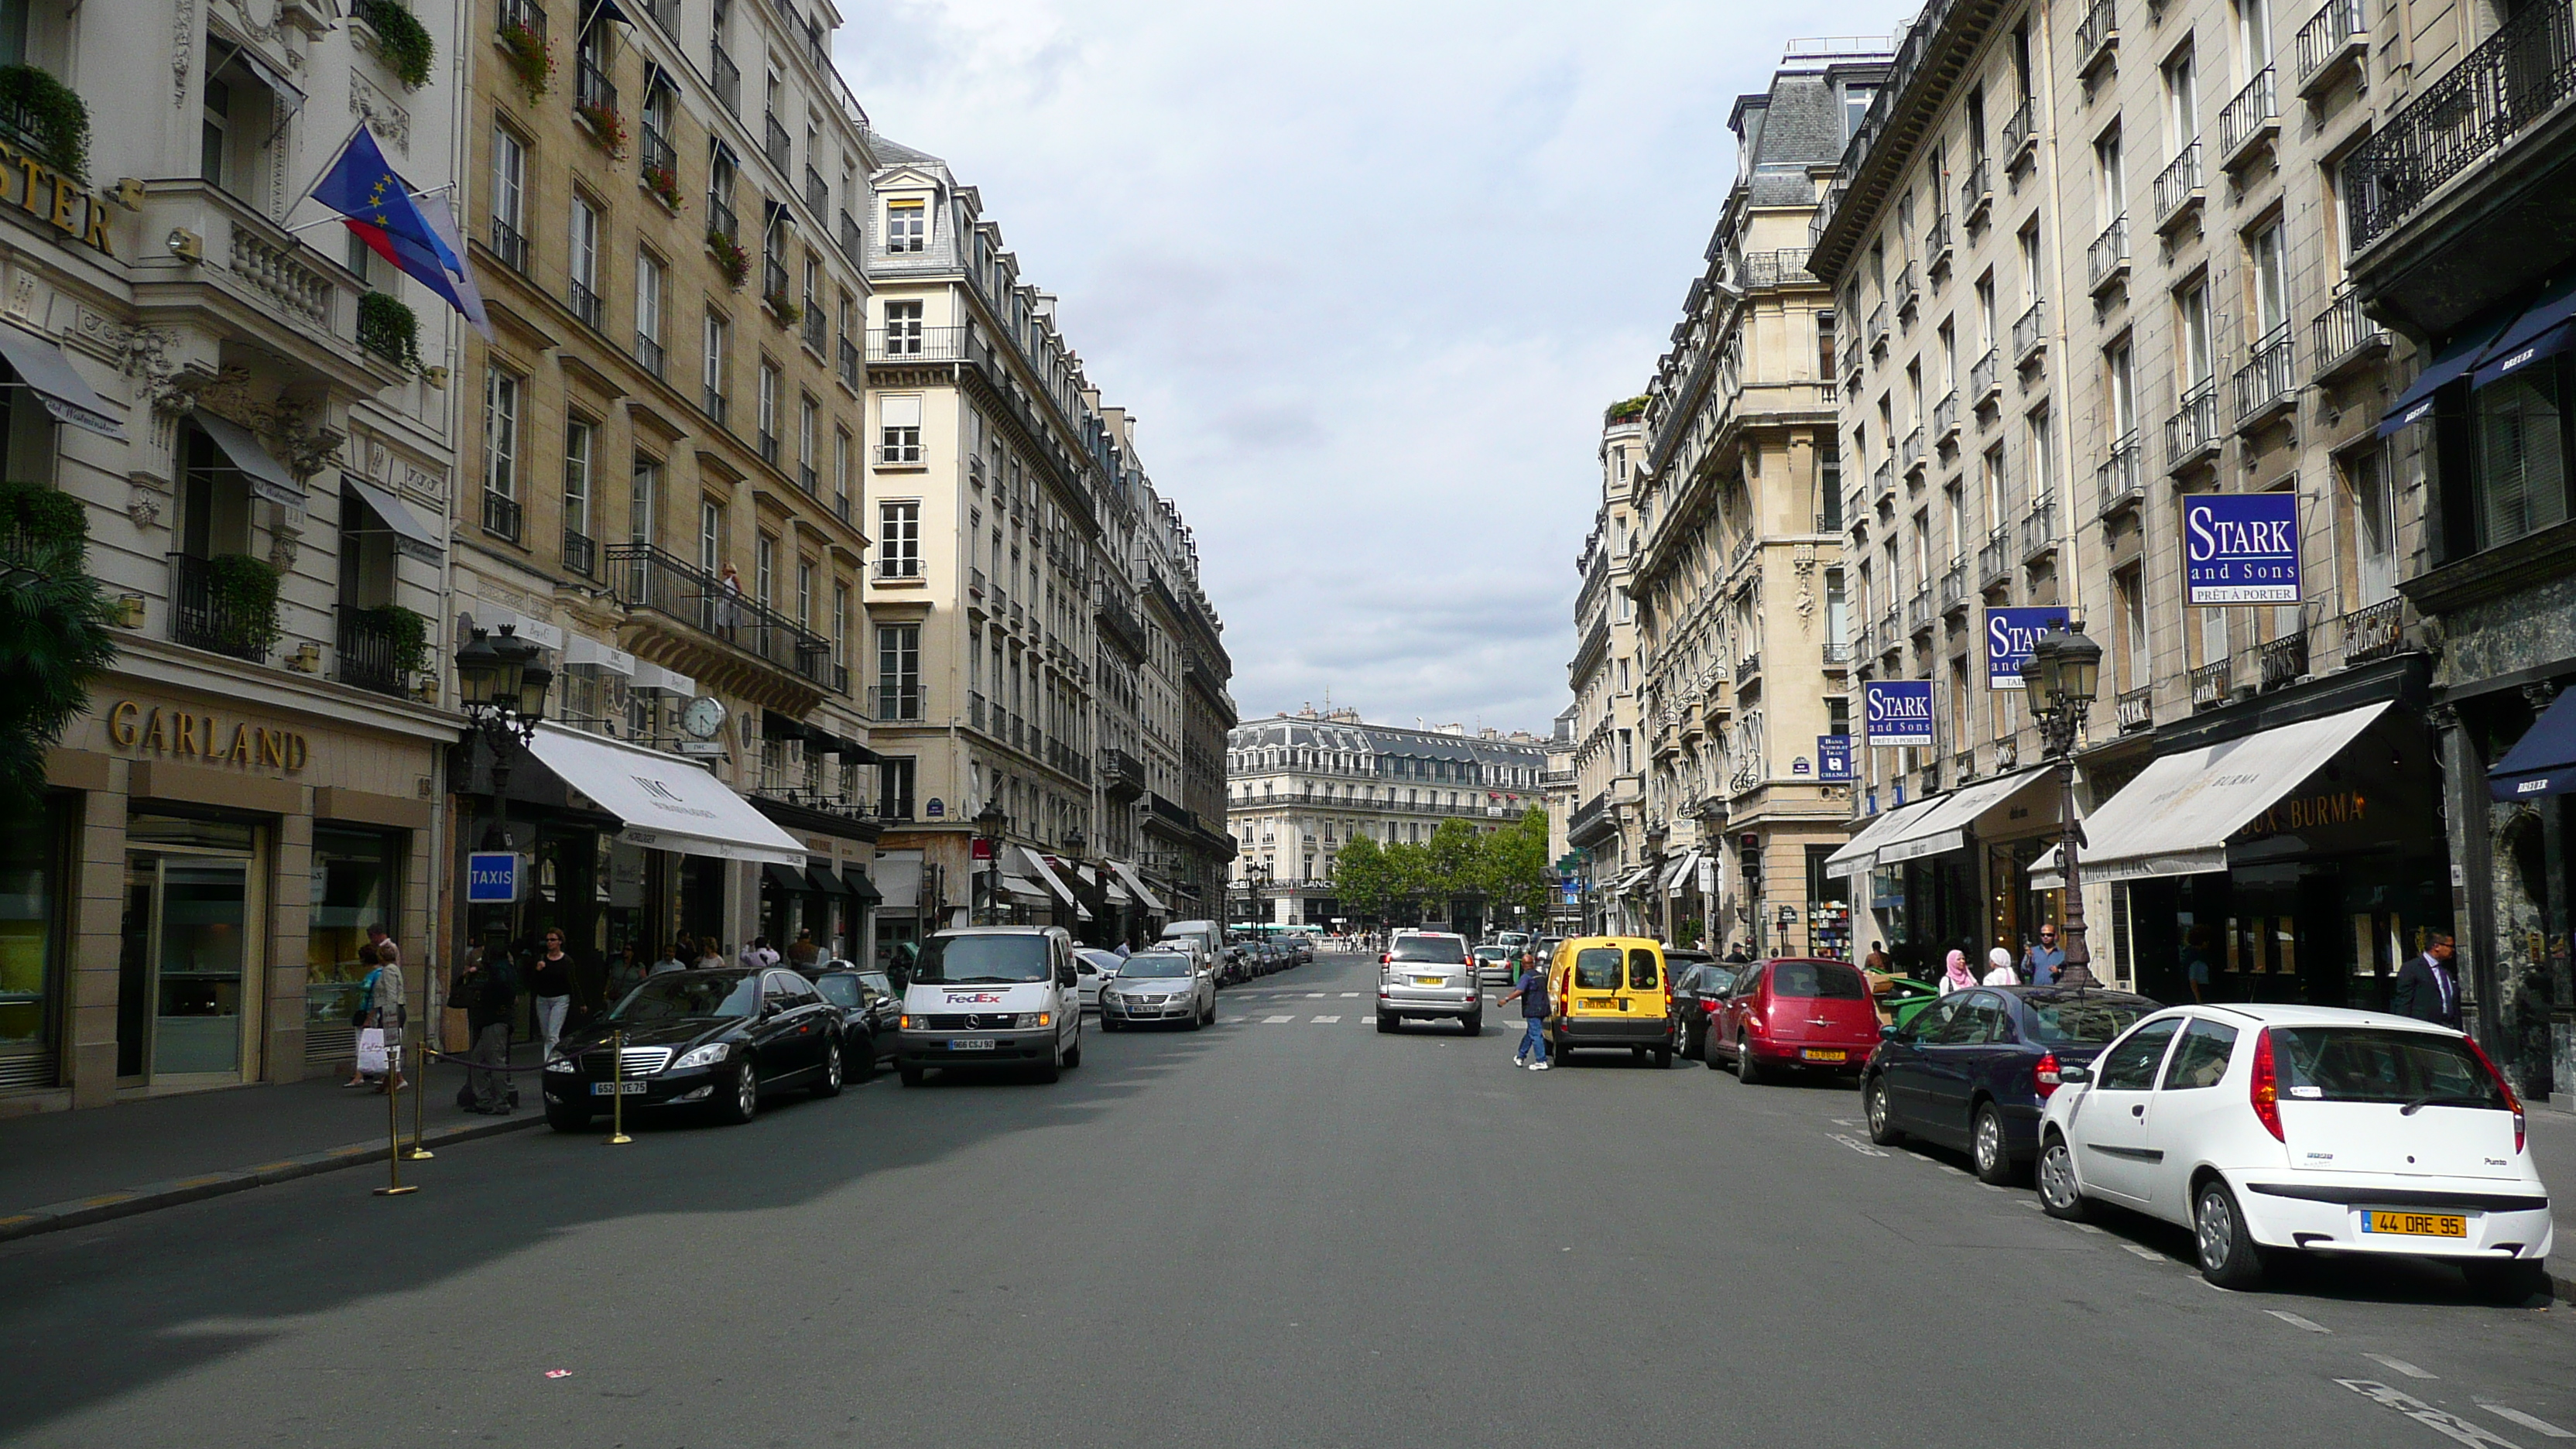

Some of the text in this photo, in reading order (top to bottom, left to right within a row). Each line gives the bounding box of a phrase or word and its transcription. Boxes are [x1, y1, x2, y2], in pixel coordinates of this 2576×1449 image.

[2189, 506, 2293, 562] STARK
[2191, 563, 2295, 580] and Sons
[2197, 587, 2292, 601] PRÊT À PORTER
[1990, 616, 2065, 658] STAR
[1992, 659, 2019, 672] and
[1869, 688, 1929, 721] STARK
[1869, 721, 1930, 732] and Sons
[114, 701, 307, 772] GARLAND
[2211, 774, 2260, 787] BURMA
[2291, 790, 2363, 830] BURMA
[471, 870, 512, 885] TAXIS
[946, 994, 1000, 1004] FedEx
[594, 1084, 614, 1093] 652
[634, 1083, 646, 1092] 75
[2484, 1157, 2507, 1166] Punto
[2379, 1214, 2399, 1231] 44
[2441, 1218, 2459, 1235] 95
